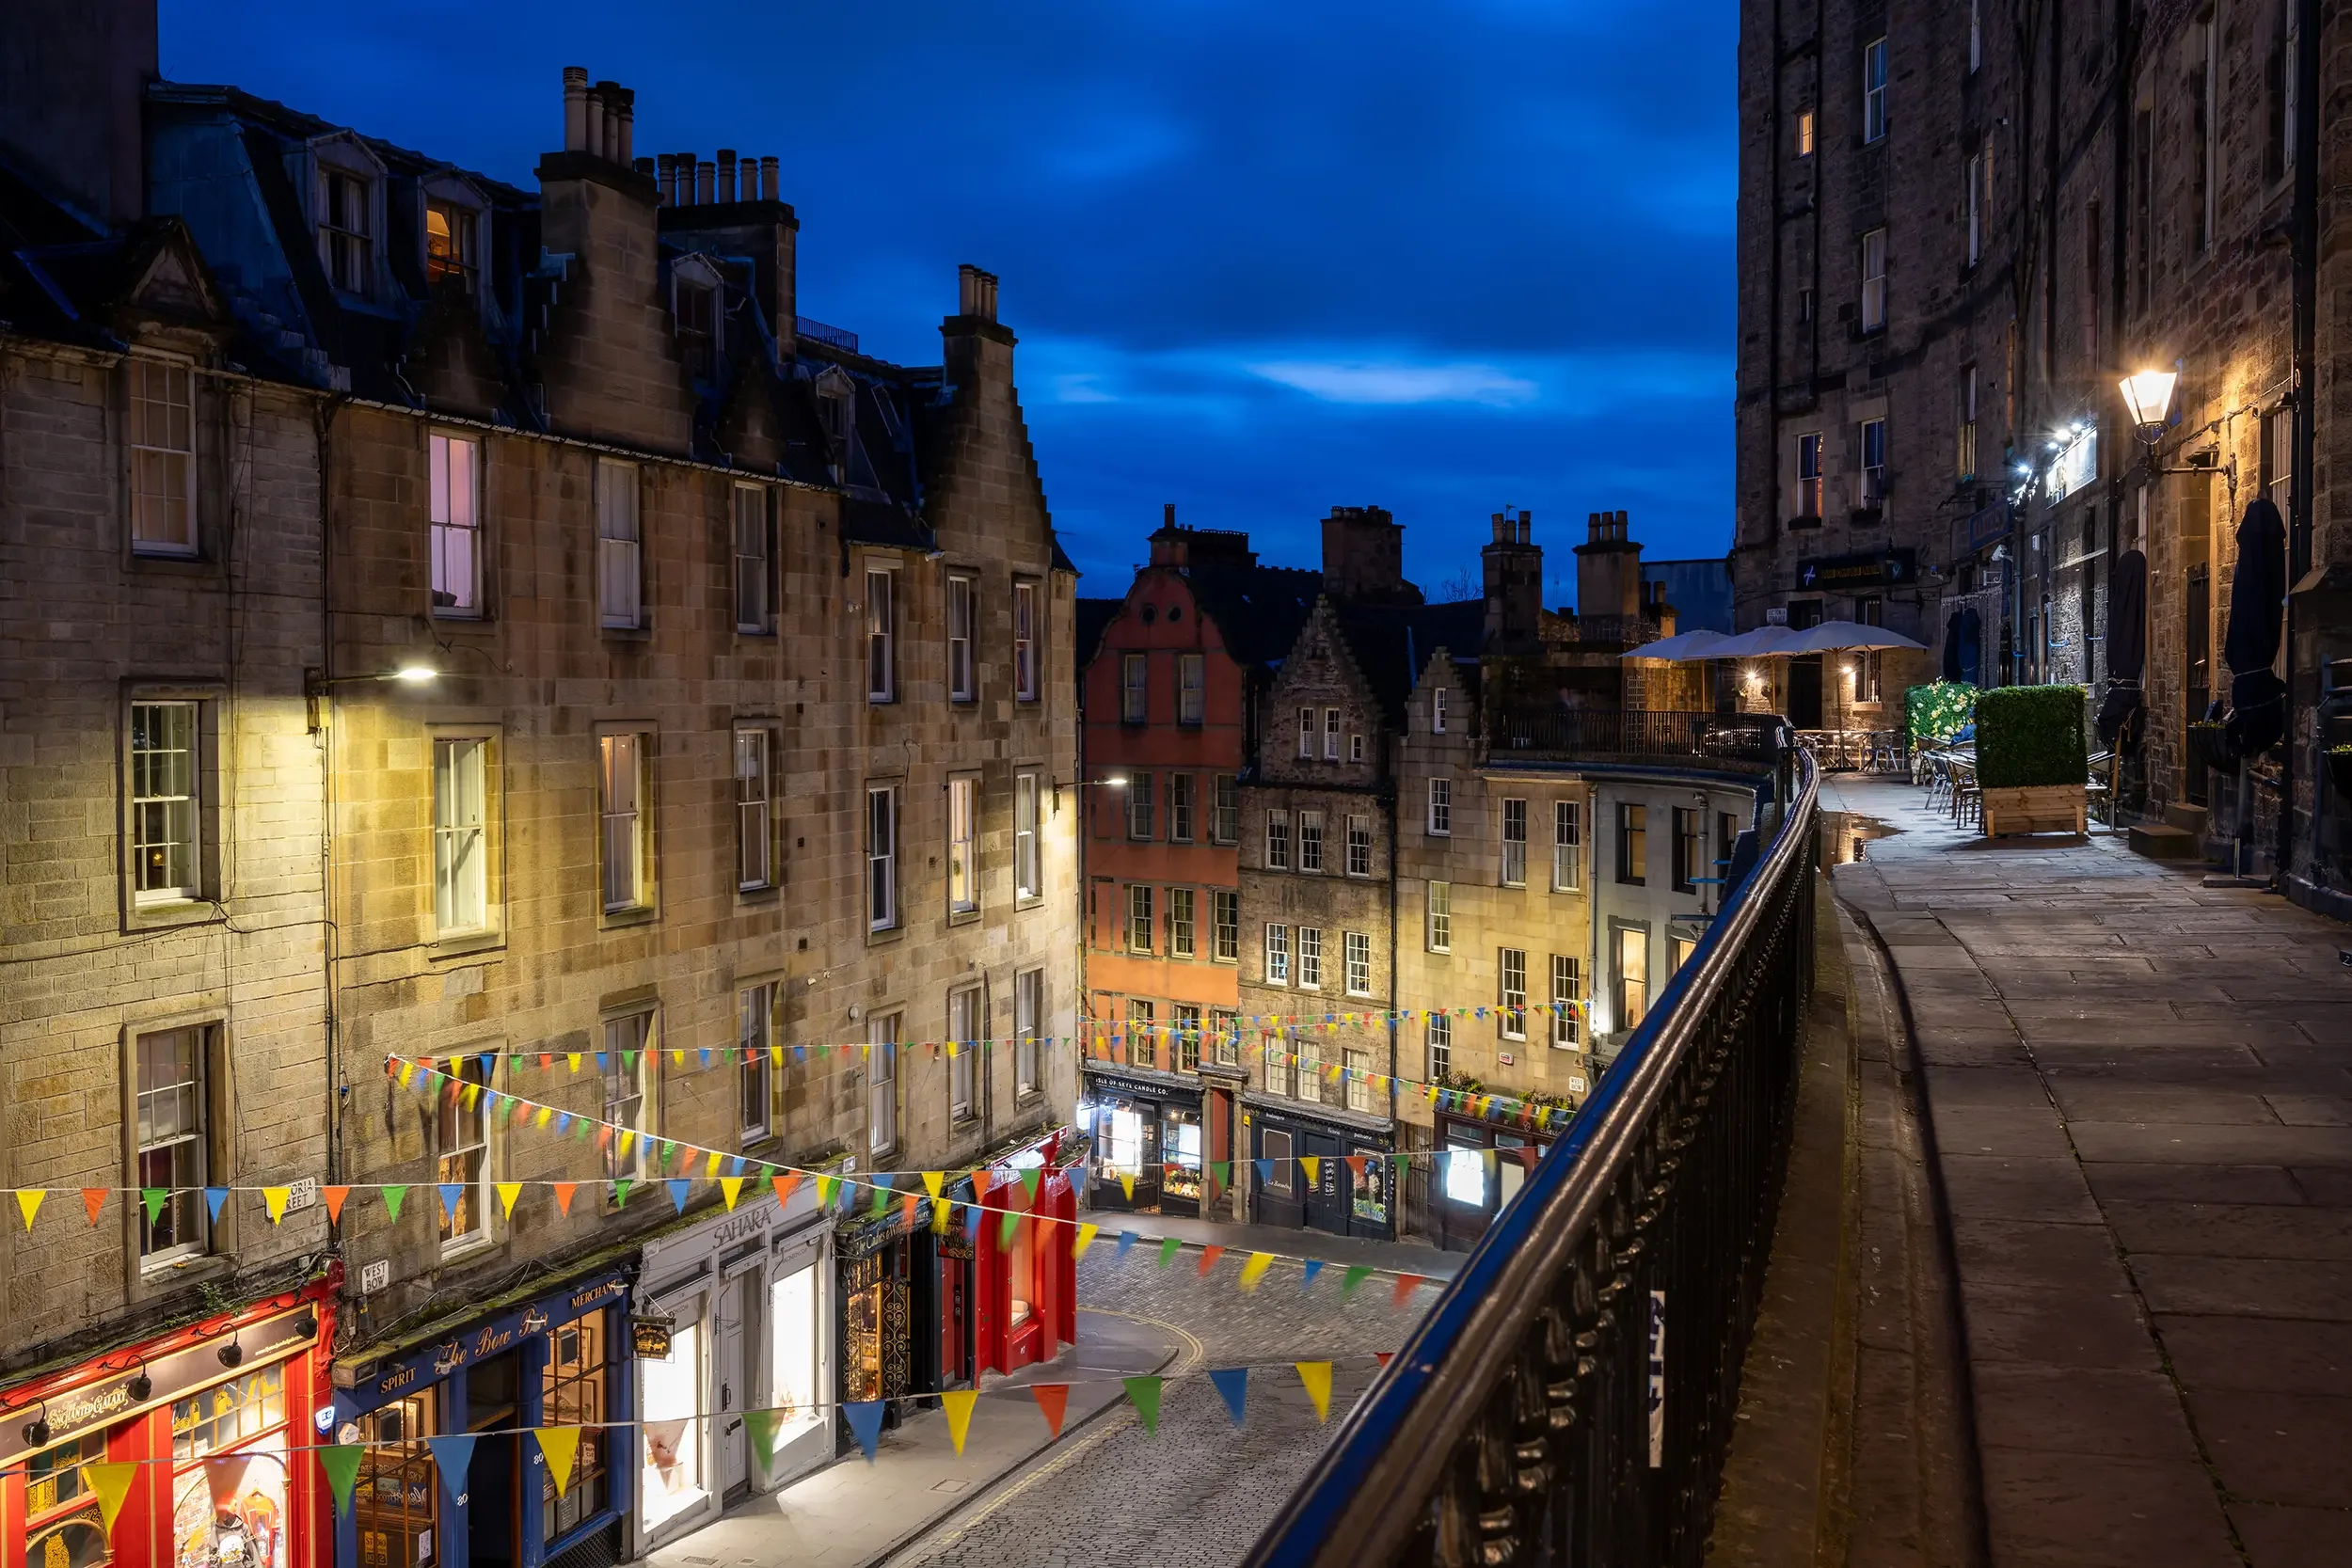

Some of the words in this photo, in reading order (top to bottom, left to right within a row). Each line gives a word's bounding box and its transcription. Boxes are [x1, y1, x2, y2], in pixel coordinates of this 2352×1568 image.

[1134, 1084, 1156, 1094] CANDLE
[291, 1180, 313, 1196] ORIA
[285, 1193, 308, 1210] REET
[712, 1207, 771, 1249] SAHARA
[364, 1261, 387, 1278] WEST
[366, 1275, 386, 1291] BOW
[380, 1367, 417, 1394] SPIRIT
[474, 1326, 512, 1357] Bow
[571, 1278, 619, 1309] MERCHANT
[532, 1451, 545, 1465] 80
[456, 1493, 469, 1506] 80
